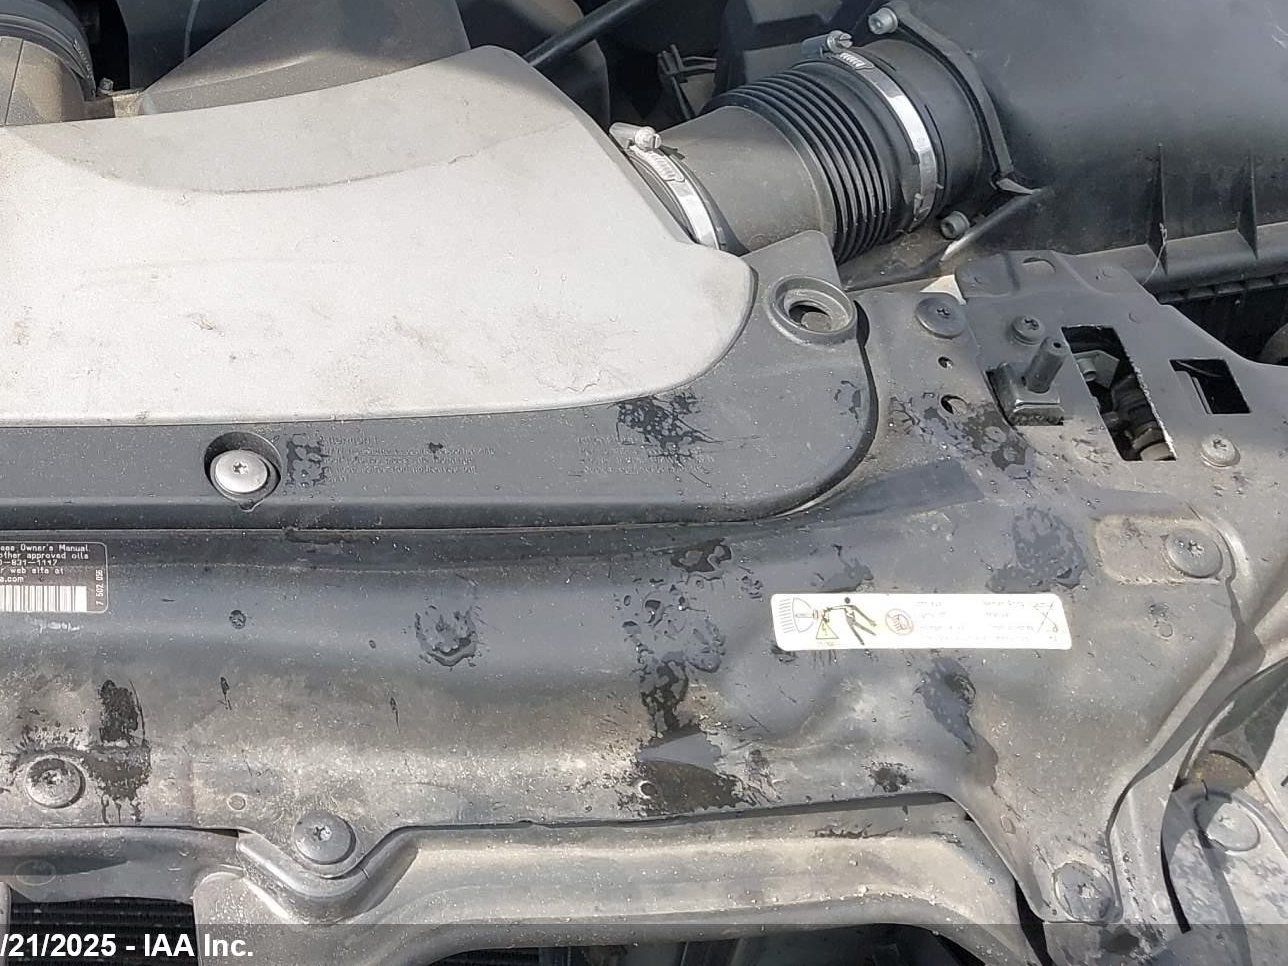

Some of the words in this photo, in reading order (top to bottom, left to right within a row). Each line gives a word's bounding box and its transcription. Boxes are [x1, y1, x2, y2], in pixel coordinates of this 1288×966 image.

[20, 543, 54, 552] Owner's
[27, 552, 67, 561] approved
[71, 551, 89, 559] oils
[10, 566, 26, 574] web
[31, 566, 49, 574] site
